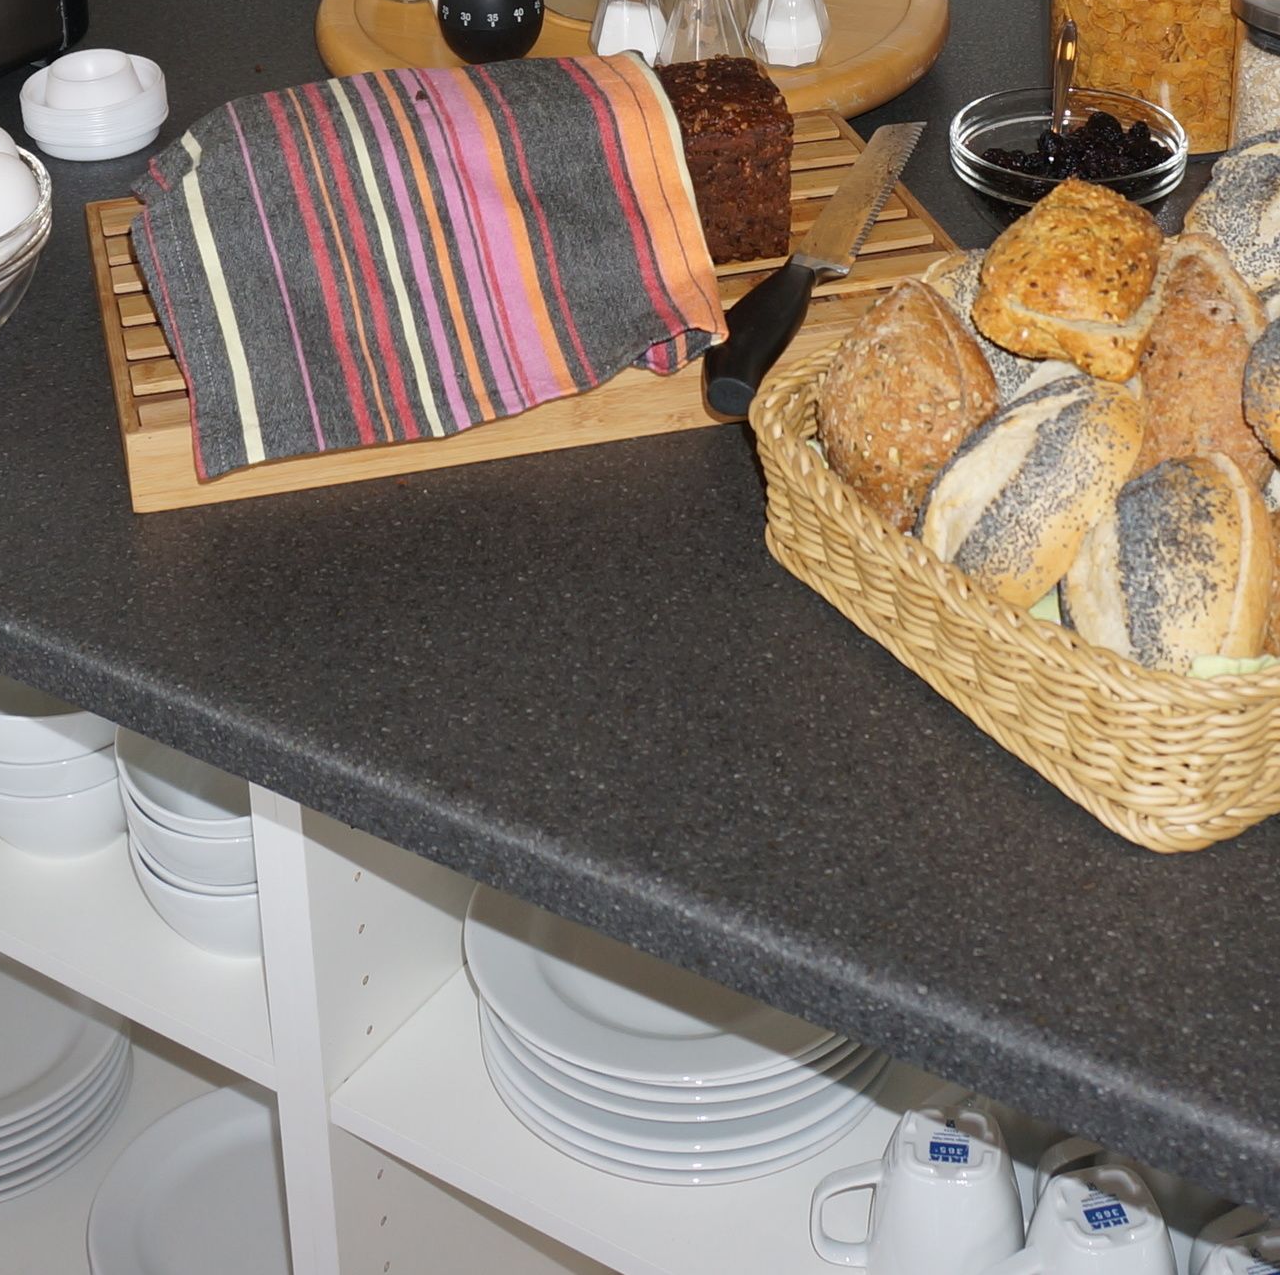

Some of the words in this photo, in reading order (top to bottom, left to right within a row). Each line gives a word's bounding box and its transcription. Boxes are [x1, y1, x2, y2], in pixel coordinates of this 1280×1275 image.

[460, 11, 472, 21] 30
[486, 13, 499, 22] 35
[513, 7, 524, 17] 40
